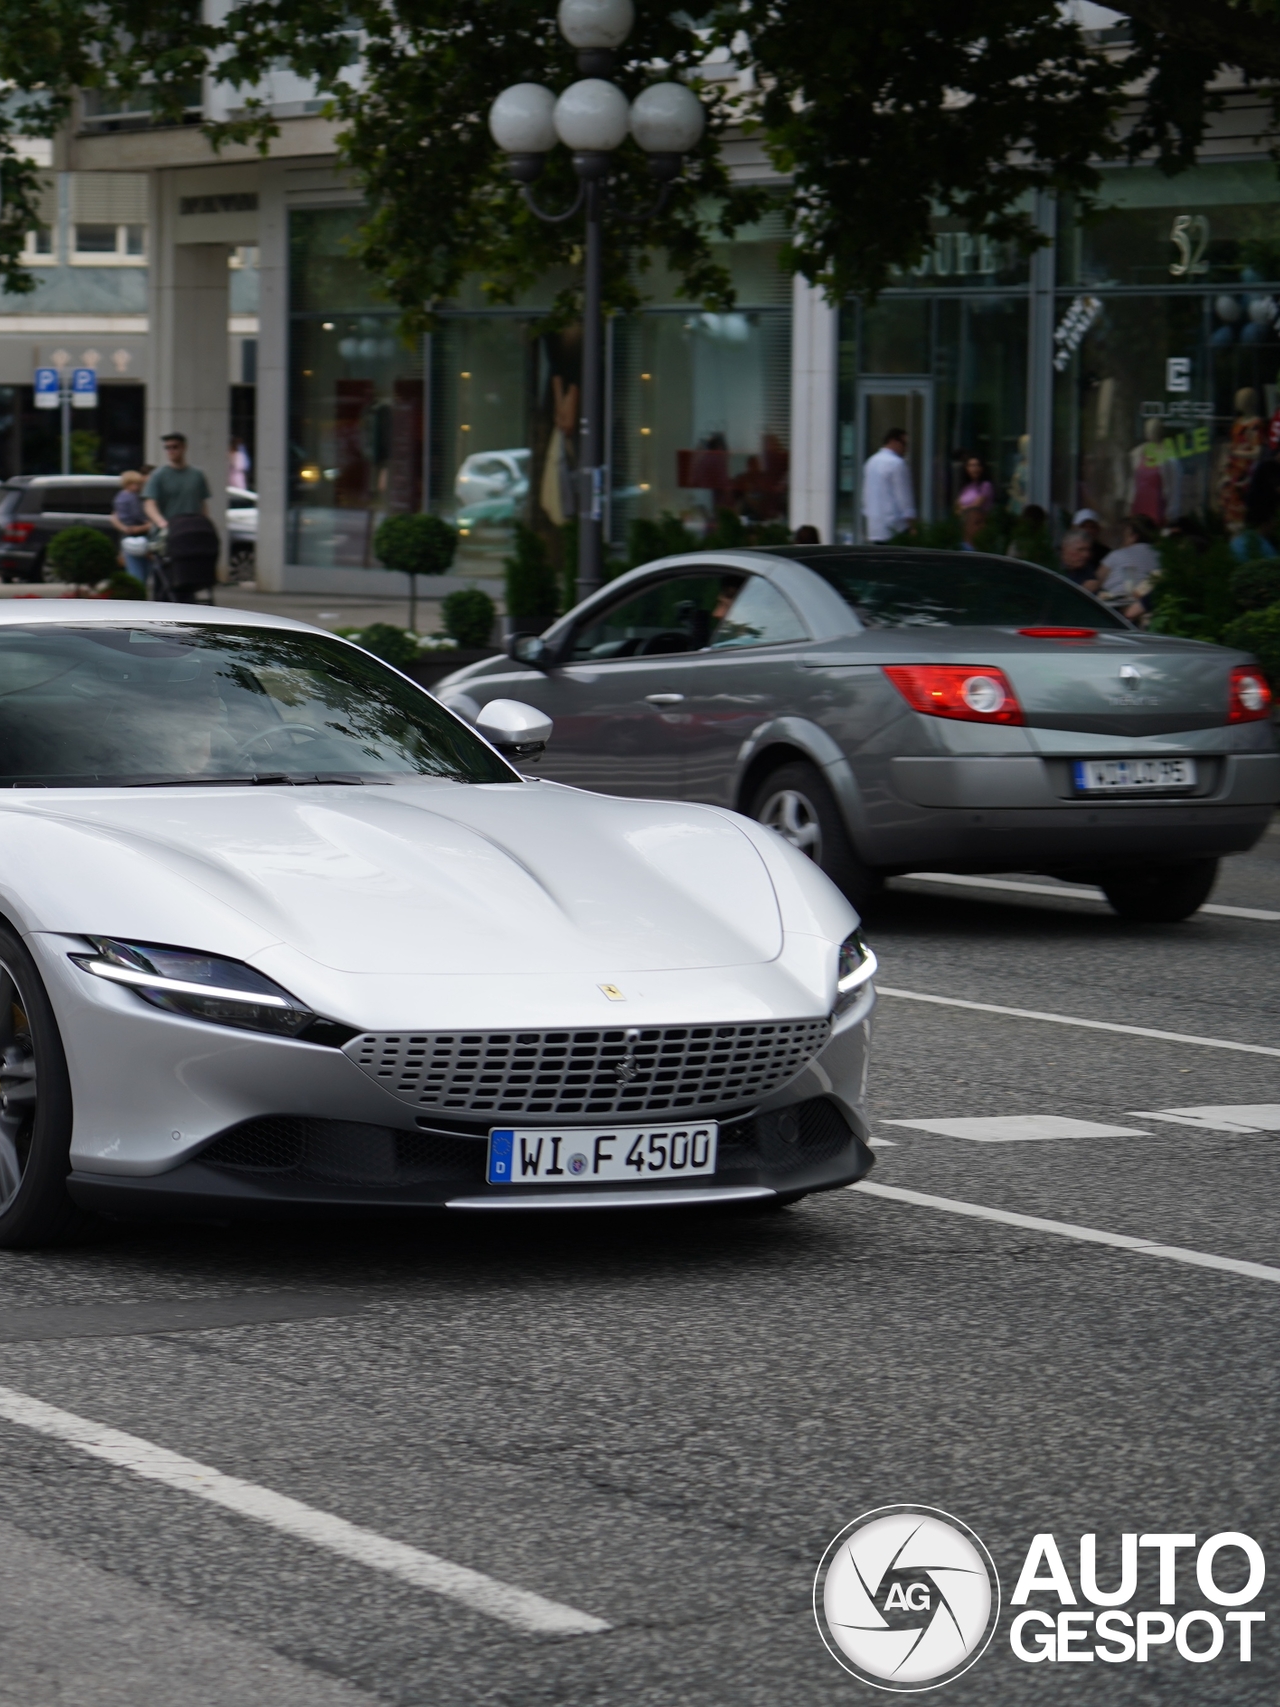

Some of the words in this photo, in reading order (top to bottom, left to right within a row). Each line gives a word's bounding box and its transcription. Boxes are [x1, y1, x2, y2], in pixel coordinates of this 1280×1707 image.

[1170, 215, 1210, 276] 52
[39, 370, 54, 390] P
[76, 370, 91, 390] P
[1143, 427, 1211, 467] SALE
[495, 1161, 506, 1174] D
[520, 1136, 564, 1176] WI
[593, 1135, 617, 1174] F
[625, 1129, 710, 1172] 4500
